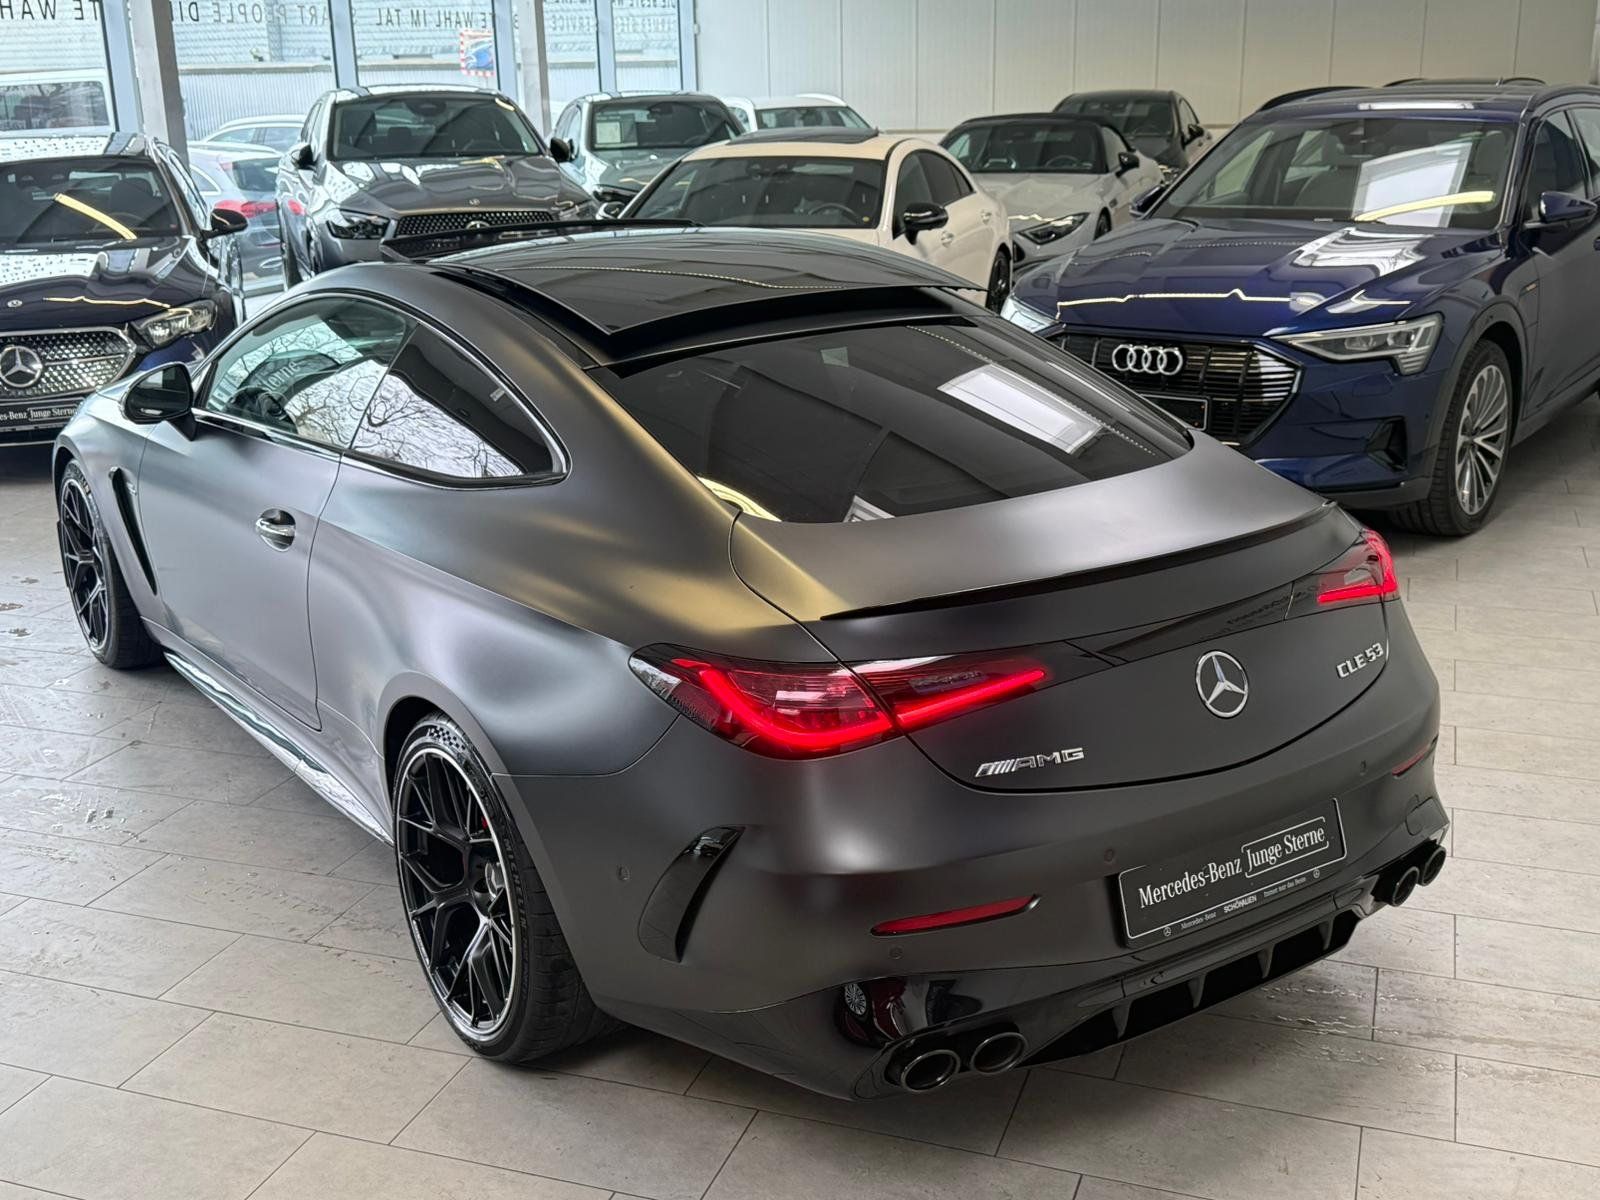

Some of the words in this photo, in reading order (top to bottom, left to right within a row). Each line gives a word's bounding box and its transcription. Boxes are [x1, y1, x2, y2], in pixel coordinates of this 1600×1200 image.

[30, 409, 52, 420] Junge
[1336, 653, 1367, 678] CLE
[1365, 642, 1384, 662] 53
[975, 747, 1085, 778] AMG
[1138, 857, 1243, 909] Mercedes-Benz
[1246, 842, 1283, 873] Junge
[1284, 826, 1326, 855] Sterne
